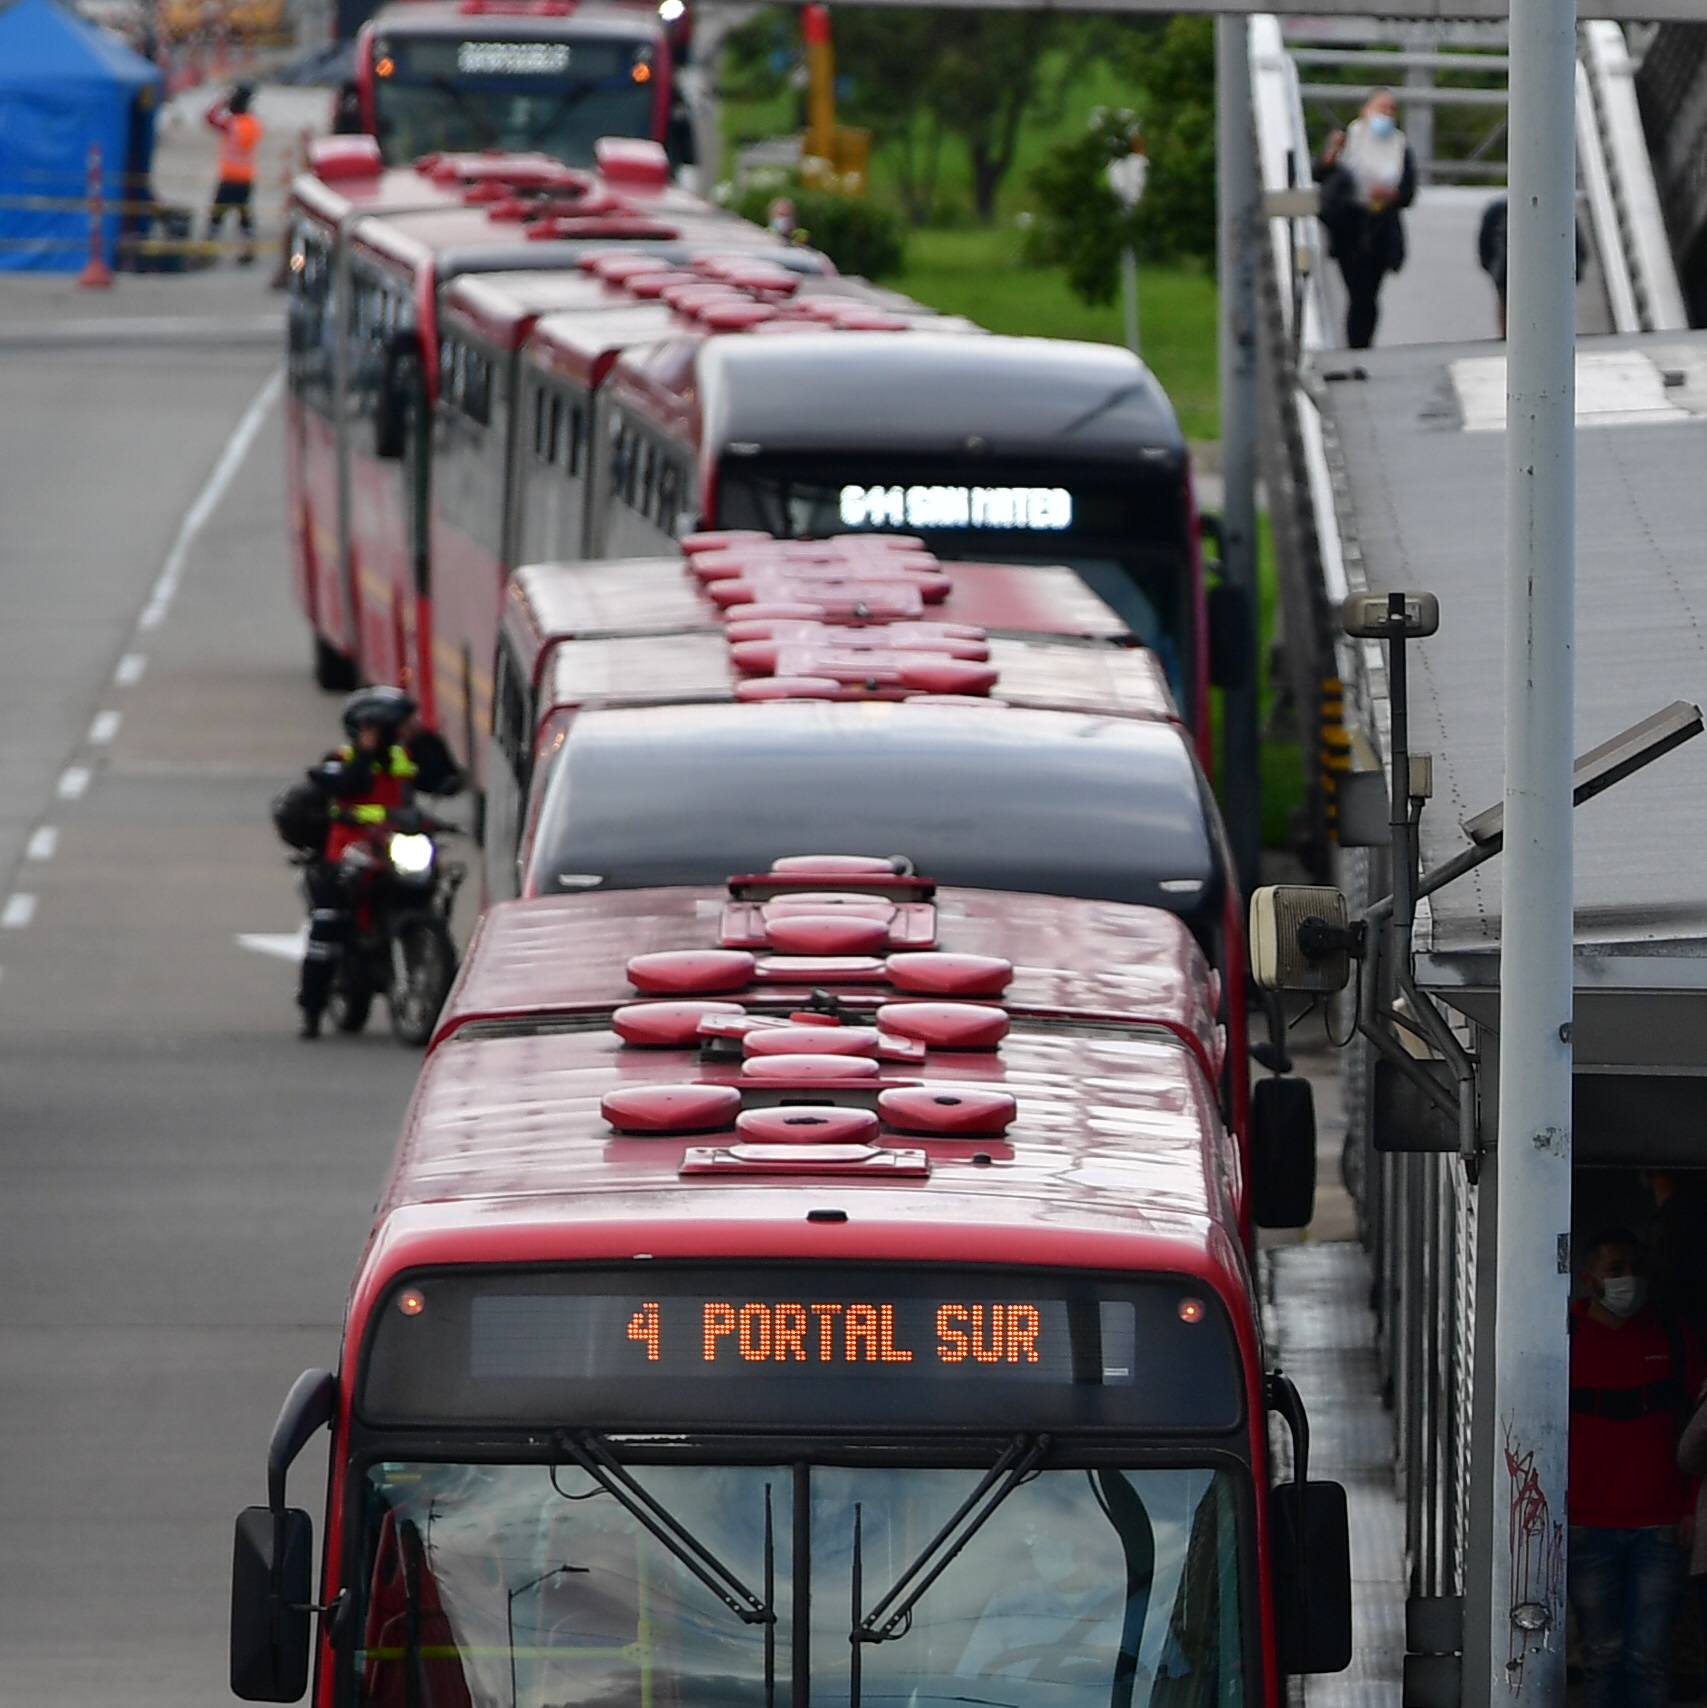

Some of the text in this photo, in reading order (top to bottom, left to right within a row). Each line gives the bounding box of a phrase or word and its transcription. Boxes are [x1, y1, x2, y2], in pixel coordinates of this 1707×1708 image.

[626, 1302, 1041, 1363] 4 PORTAL SUR
